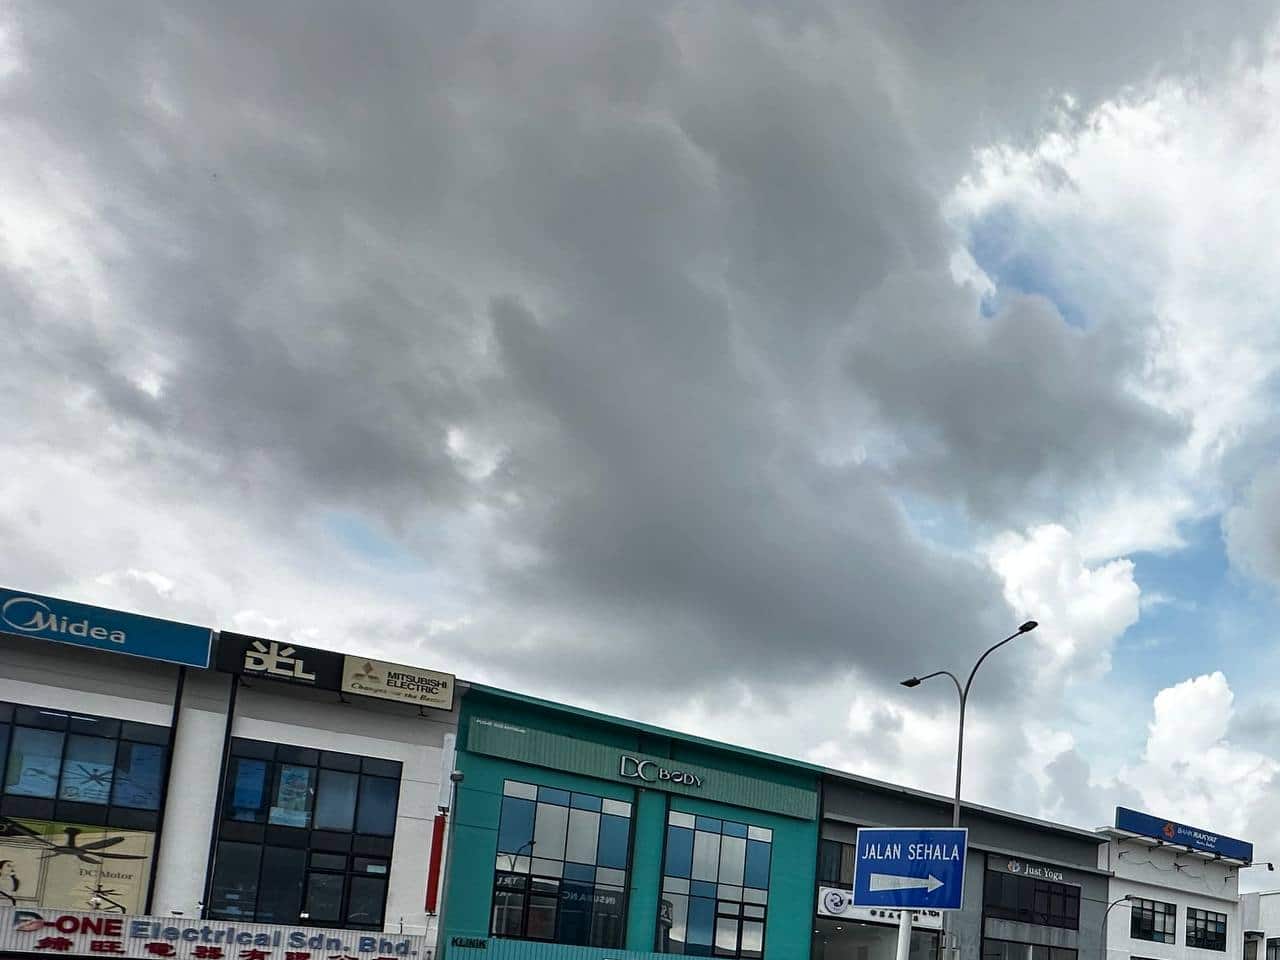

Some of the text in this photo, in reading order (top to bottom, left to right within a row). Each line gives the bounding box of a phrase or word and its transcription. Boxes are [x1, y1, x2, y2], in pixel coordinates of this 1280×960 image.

[22, 610, 126, 644] Midea
[386, 679, 439, 695] ELECTRIC
[387, 671, 448, 689] MITSUBISHI
[621, 755, 704, 786] DC BODY
[861, 843, 960, 860] JALAN SEHALA
[100, 870, 134, 881] Motor
[1024, 864, 1063, 880] Just Yoga
[14, 910, 418, 956] D-ONE Electrical Sdn. Bhd.
[451, 936, 489, 949] KLINIK
